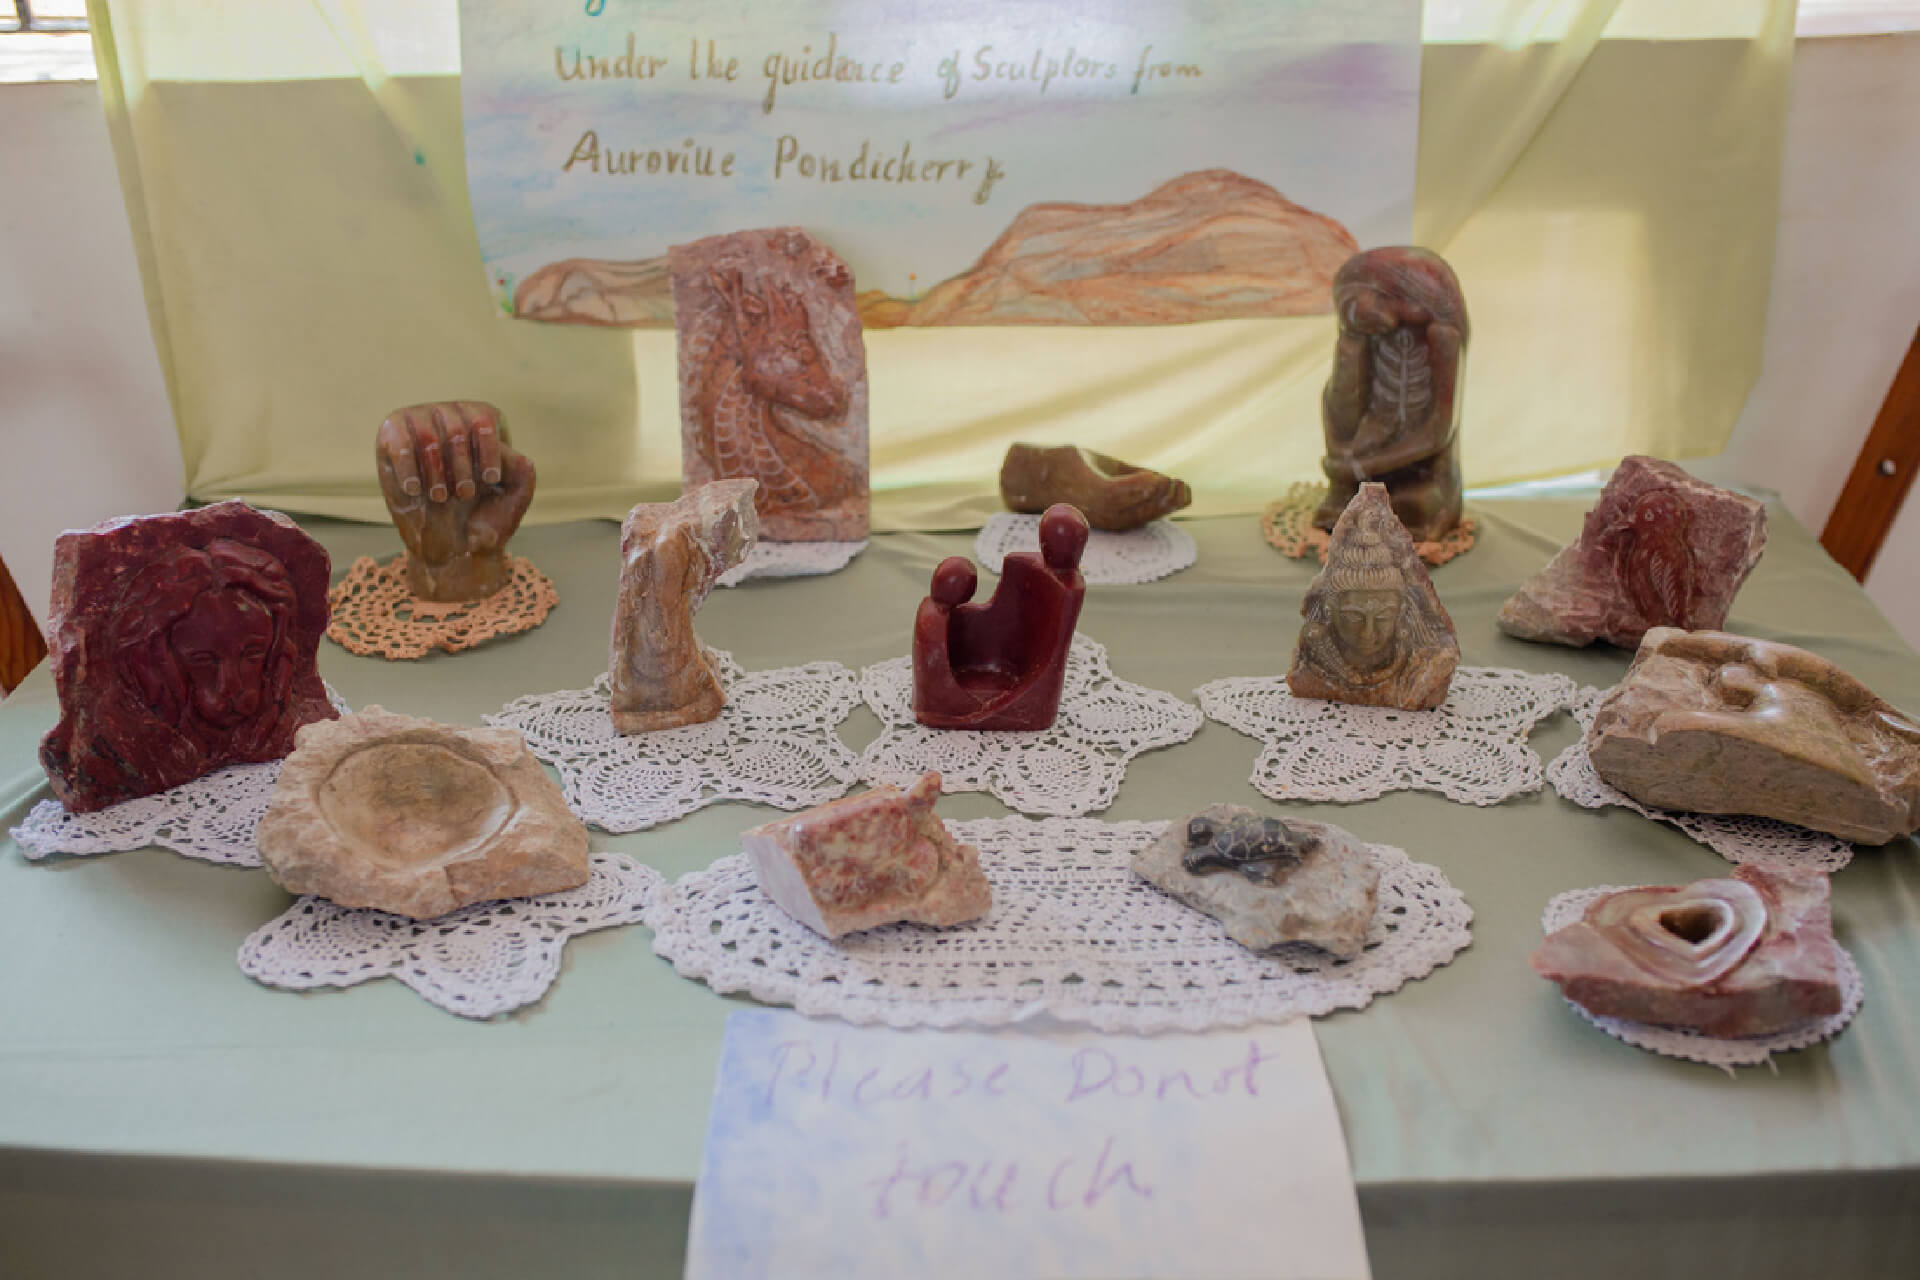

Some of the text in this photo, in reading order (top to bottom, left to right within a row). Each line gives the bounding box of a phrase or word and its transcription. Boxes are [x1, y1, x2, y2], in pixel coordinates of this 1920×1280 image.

[554, 30, 668, 82] Under
[760, 30, 906, 115] guidance
[937, 48, 962, 100] of
[1130, 44, 1205, 96] from
[562, 130, 1005, 205] Auroville Pondicherry
[763, 1036, 1011, 1108] Please
[867, 1135, 1153, 1219] touch
